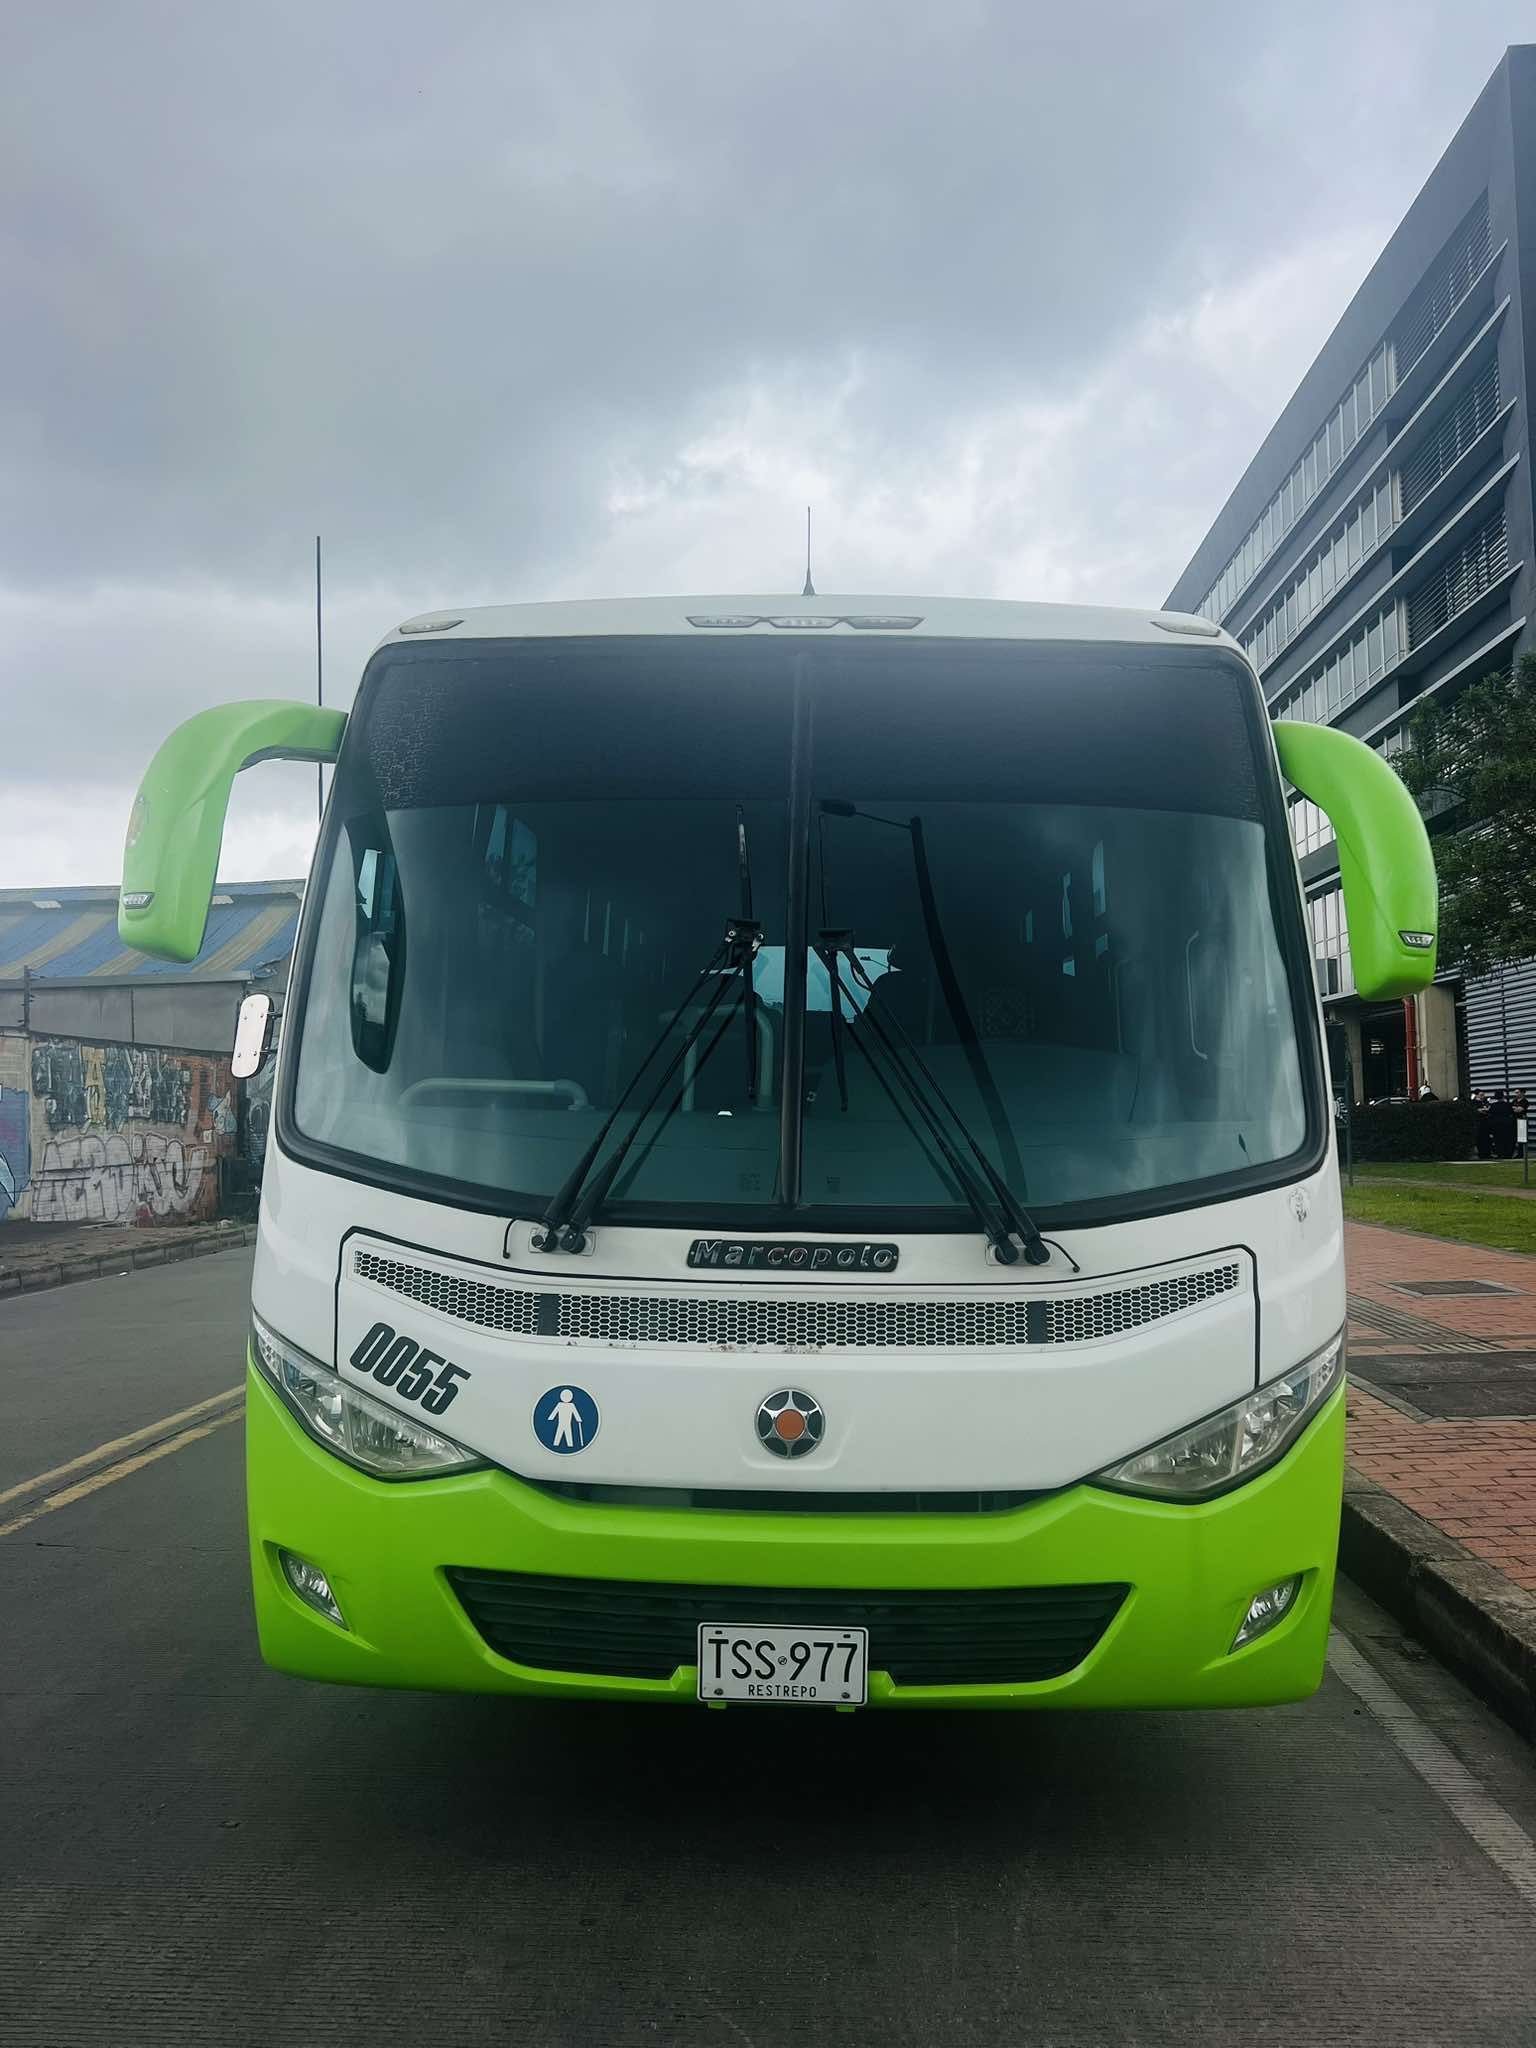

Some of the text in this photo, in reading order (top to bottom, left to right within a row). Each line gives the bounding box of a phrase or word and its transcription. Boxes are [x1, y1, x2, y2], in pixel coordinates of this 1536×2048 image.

[694, 1240, 893, 1270] Marcopolo
[349, 1321, 472, 1416] 0055
[747, 1684, 817, 1698] RESTREPO
